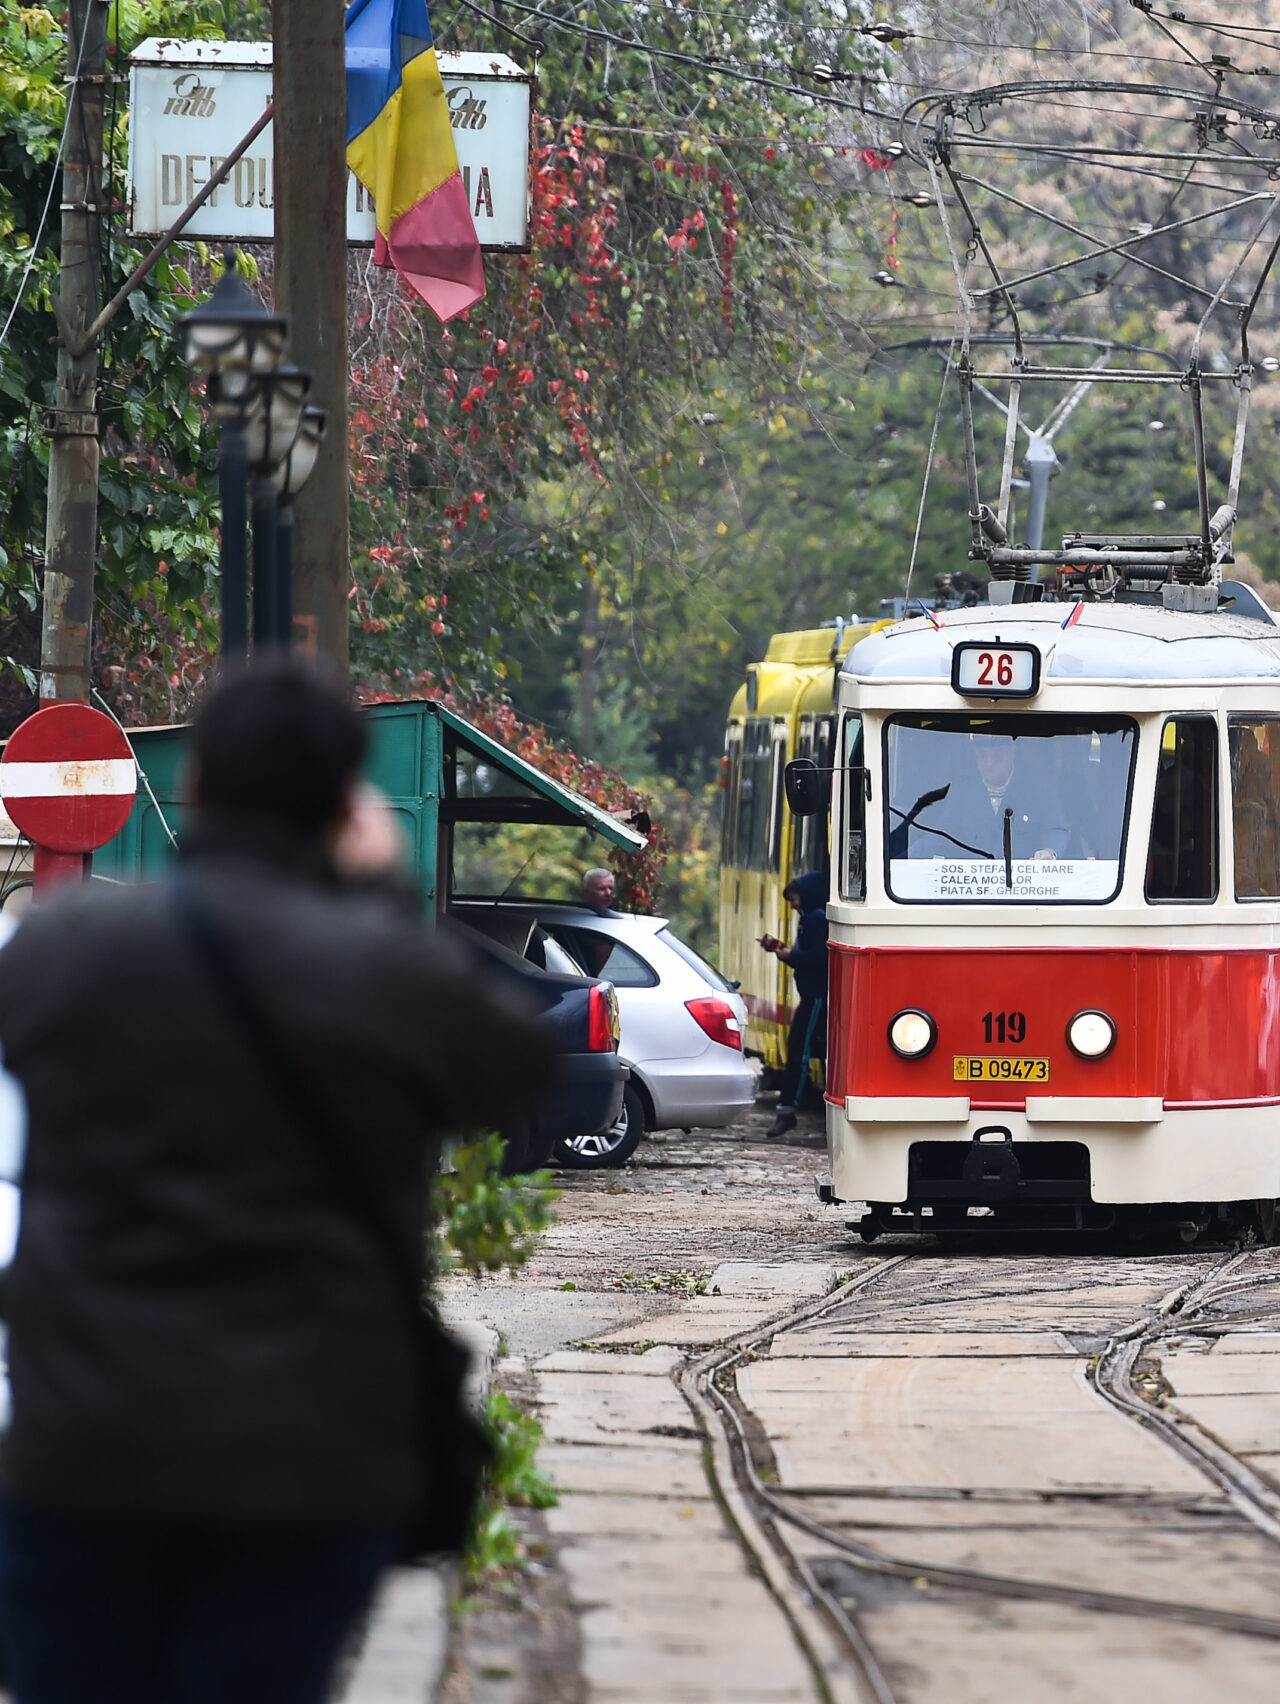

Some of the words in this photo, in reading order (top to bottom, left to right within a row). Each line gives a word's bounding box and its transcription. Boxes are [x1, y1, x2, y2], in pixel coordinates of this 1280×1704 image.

[977, 653, 1014, 686] 26
[941, 864, 967, 874] SOS.
[970, 864, 1013, 874] STEFA
[1017, 864, 1039, 874] CEL
[1042, 864, 1074, 874] MARE
[940, 875, 978, 884] CALEA
[981, 875, 1032, 884] MOSOR
[940, 886, 973, 895] PIATA
[976, 886, 993, 895] SF.
[996, 886, 1060, 895] GHEORGHE
[981, 1011, 1026, 1043] 119
[970, 1060, 983, 1078] B
[989, 1060, 1047, 1079] 09473
